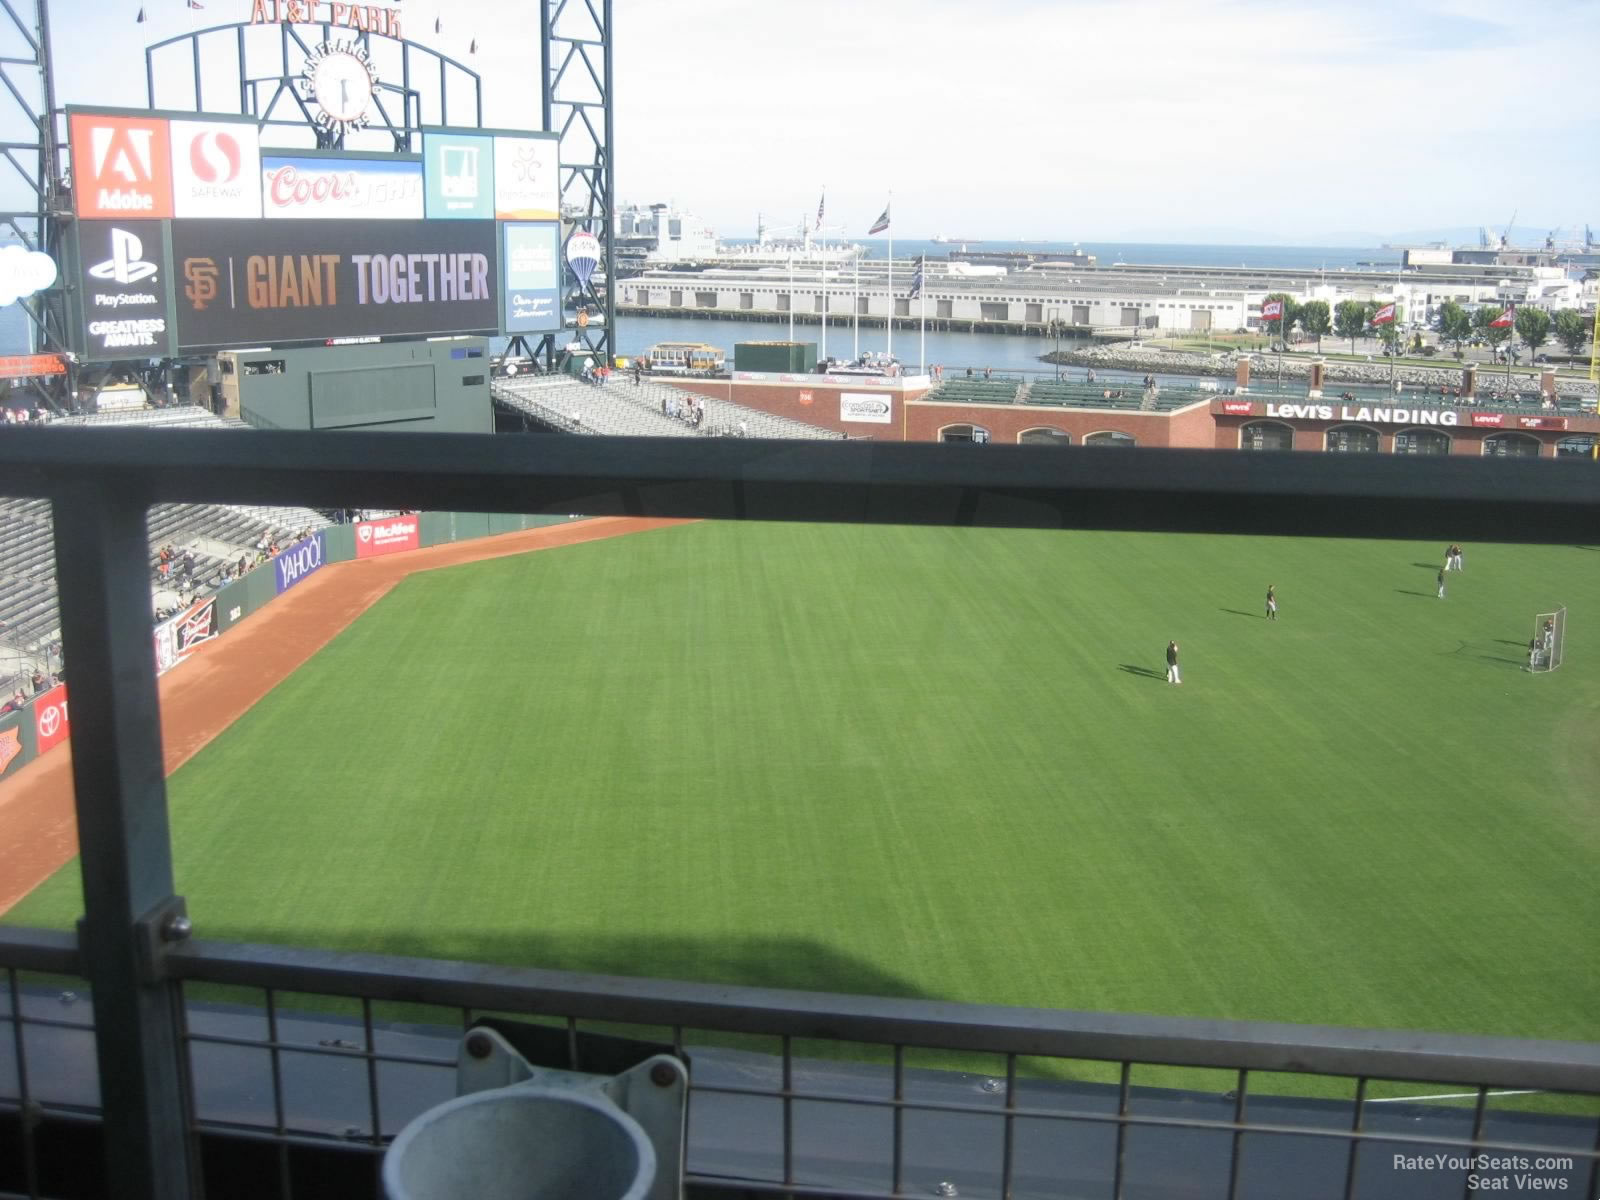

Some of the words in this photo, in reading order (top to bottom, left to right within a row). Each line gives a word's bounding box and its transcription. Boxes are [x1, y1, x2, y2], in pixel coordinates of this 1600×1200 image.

[250, 0, 320, 25] AT&T
[330, 1, 402, 41] PARK
[315, 111, 370, 135] GIANTS
[191, 187, 243, 198] SAFEWAY
[266, 164, 359, 208] Coors
[98, 188, 153, 210] Adobe
[247, 254, 341, 310] GIANT
[352, 252, 490, 305] TOGETHER
[88, 318, 166, 336] GREATNESS
[1341, 406, 1458, 426] LANDING
[374, 522, 416, 539] McAfee
[279, 534, 321, 588] YAHOO!
